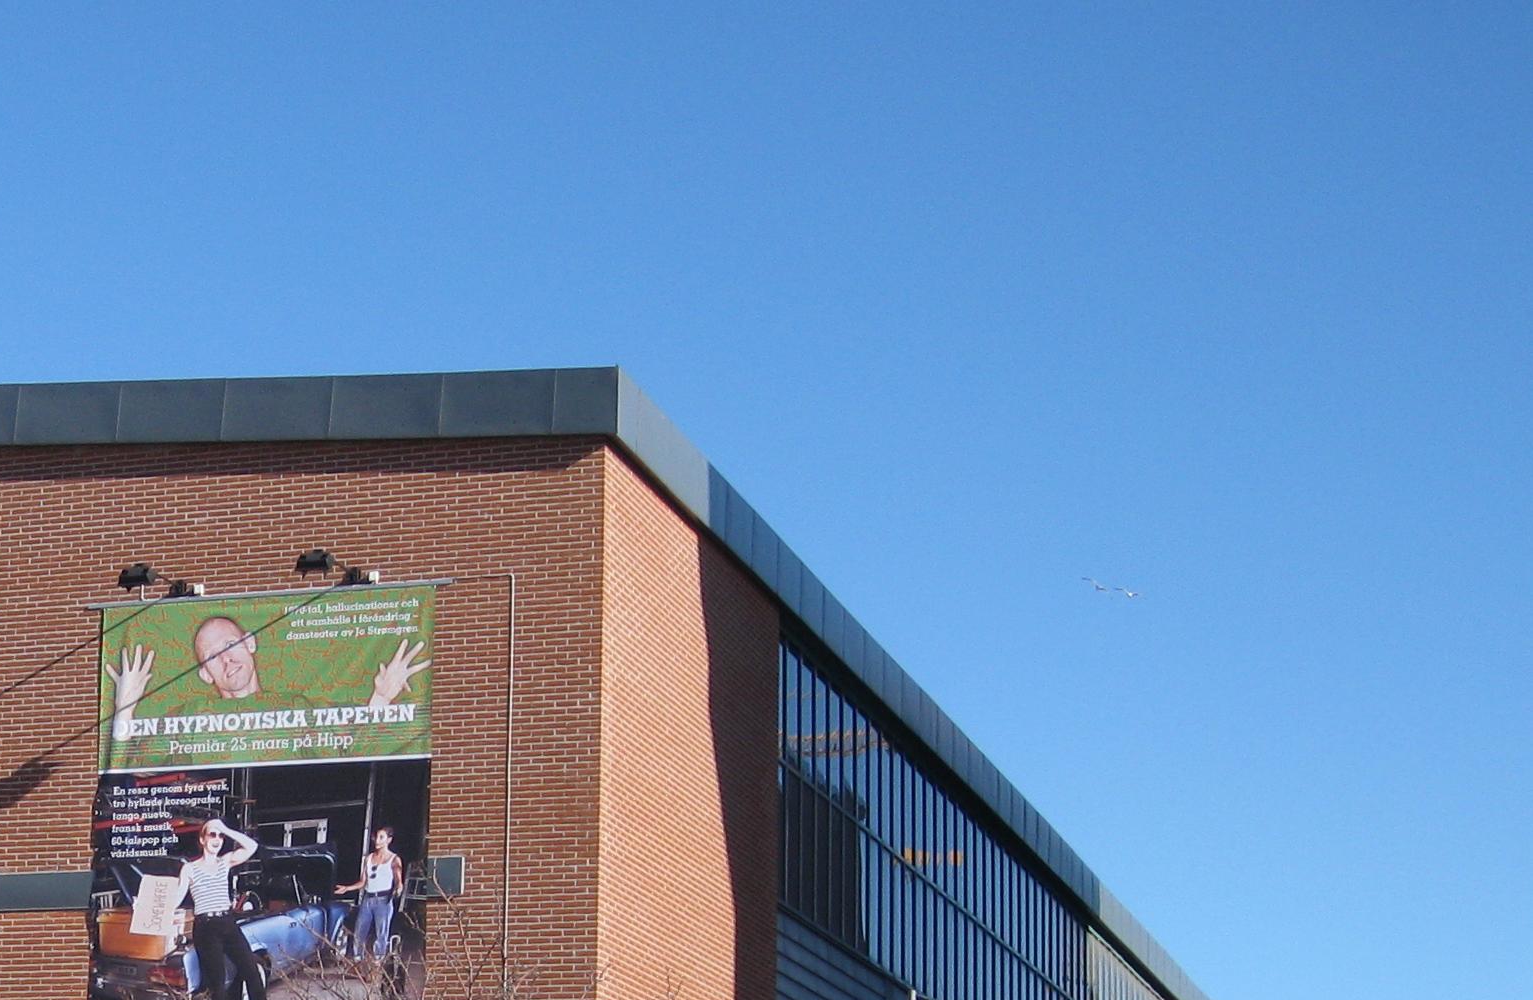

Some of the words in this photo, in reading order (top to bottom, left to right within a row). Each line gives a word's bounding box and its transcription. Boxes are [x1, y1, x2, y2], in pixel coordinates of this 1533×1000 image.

[401, 598, 419, 608] och
[291, 617, 305, 628] ett
[286, 629, 338, 641] dansteater
[341, 629, 353, 637] av
[113, 716, 158, 737] DEN
[164, 713, 307, 735] HYPNOTISKA
[313, 704, 416, 725] TAPETEN
[169, 738, 227, 755] Premiär
[230, 736, 248, 752] 25
[251, 738, 290, 750] mars
[293, 732, 313, 751] på
[317, 731, 354, 750] Hipp
[113, 786, 126, 796] En
[127, 786, 148, 795] resa
[150, 785, 183, 797] genom
[184, 782, 204, 794] fyra
[113, 799, 126, 808] tre
[127, 797, 162, 809] hyllade
[112, 811, 140, 823] tango
[112, 822, 141, 833] fransk
[111, 834, 160, 847] 60-talspop
[161, 833, 179, 844] och
